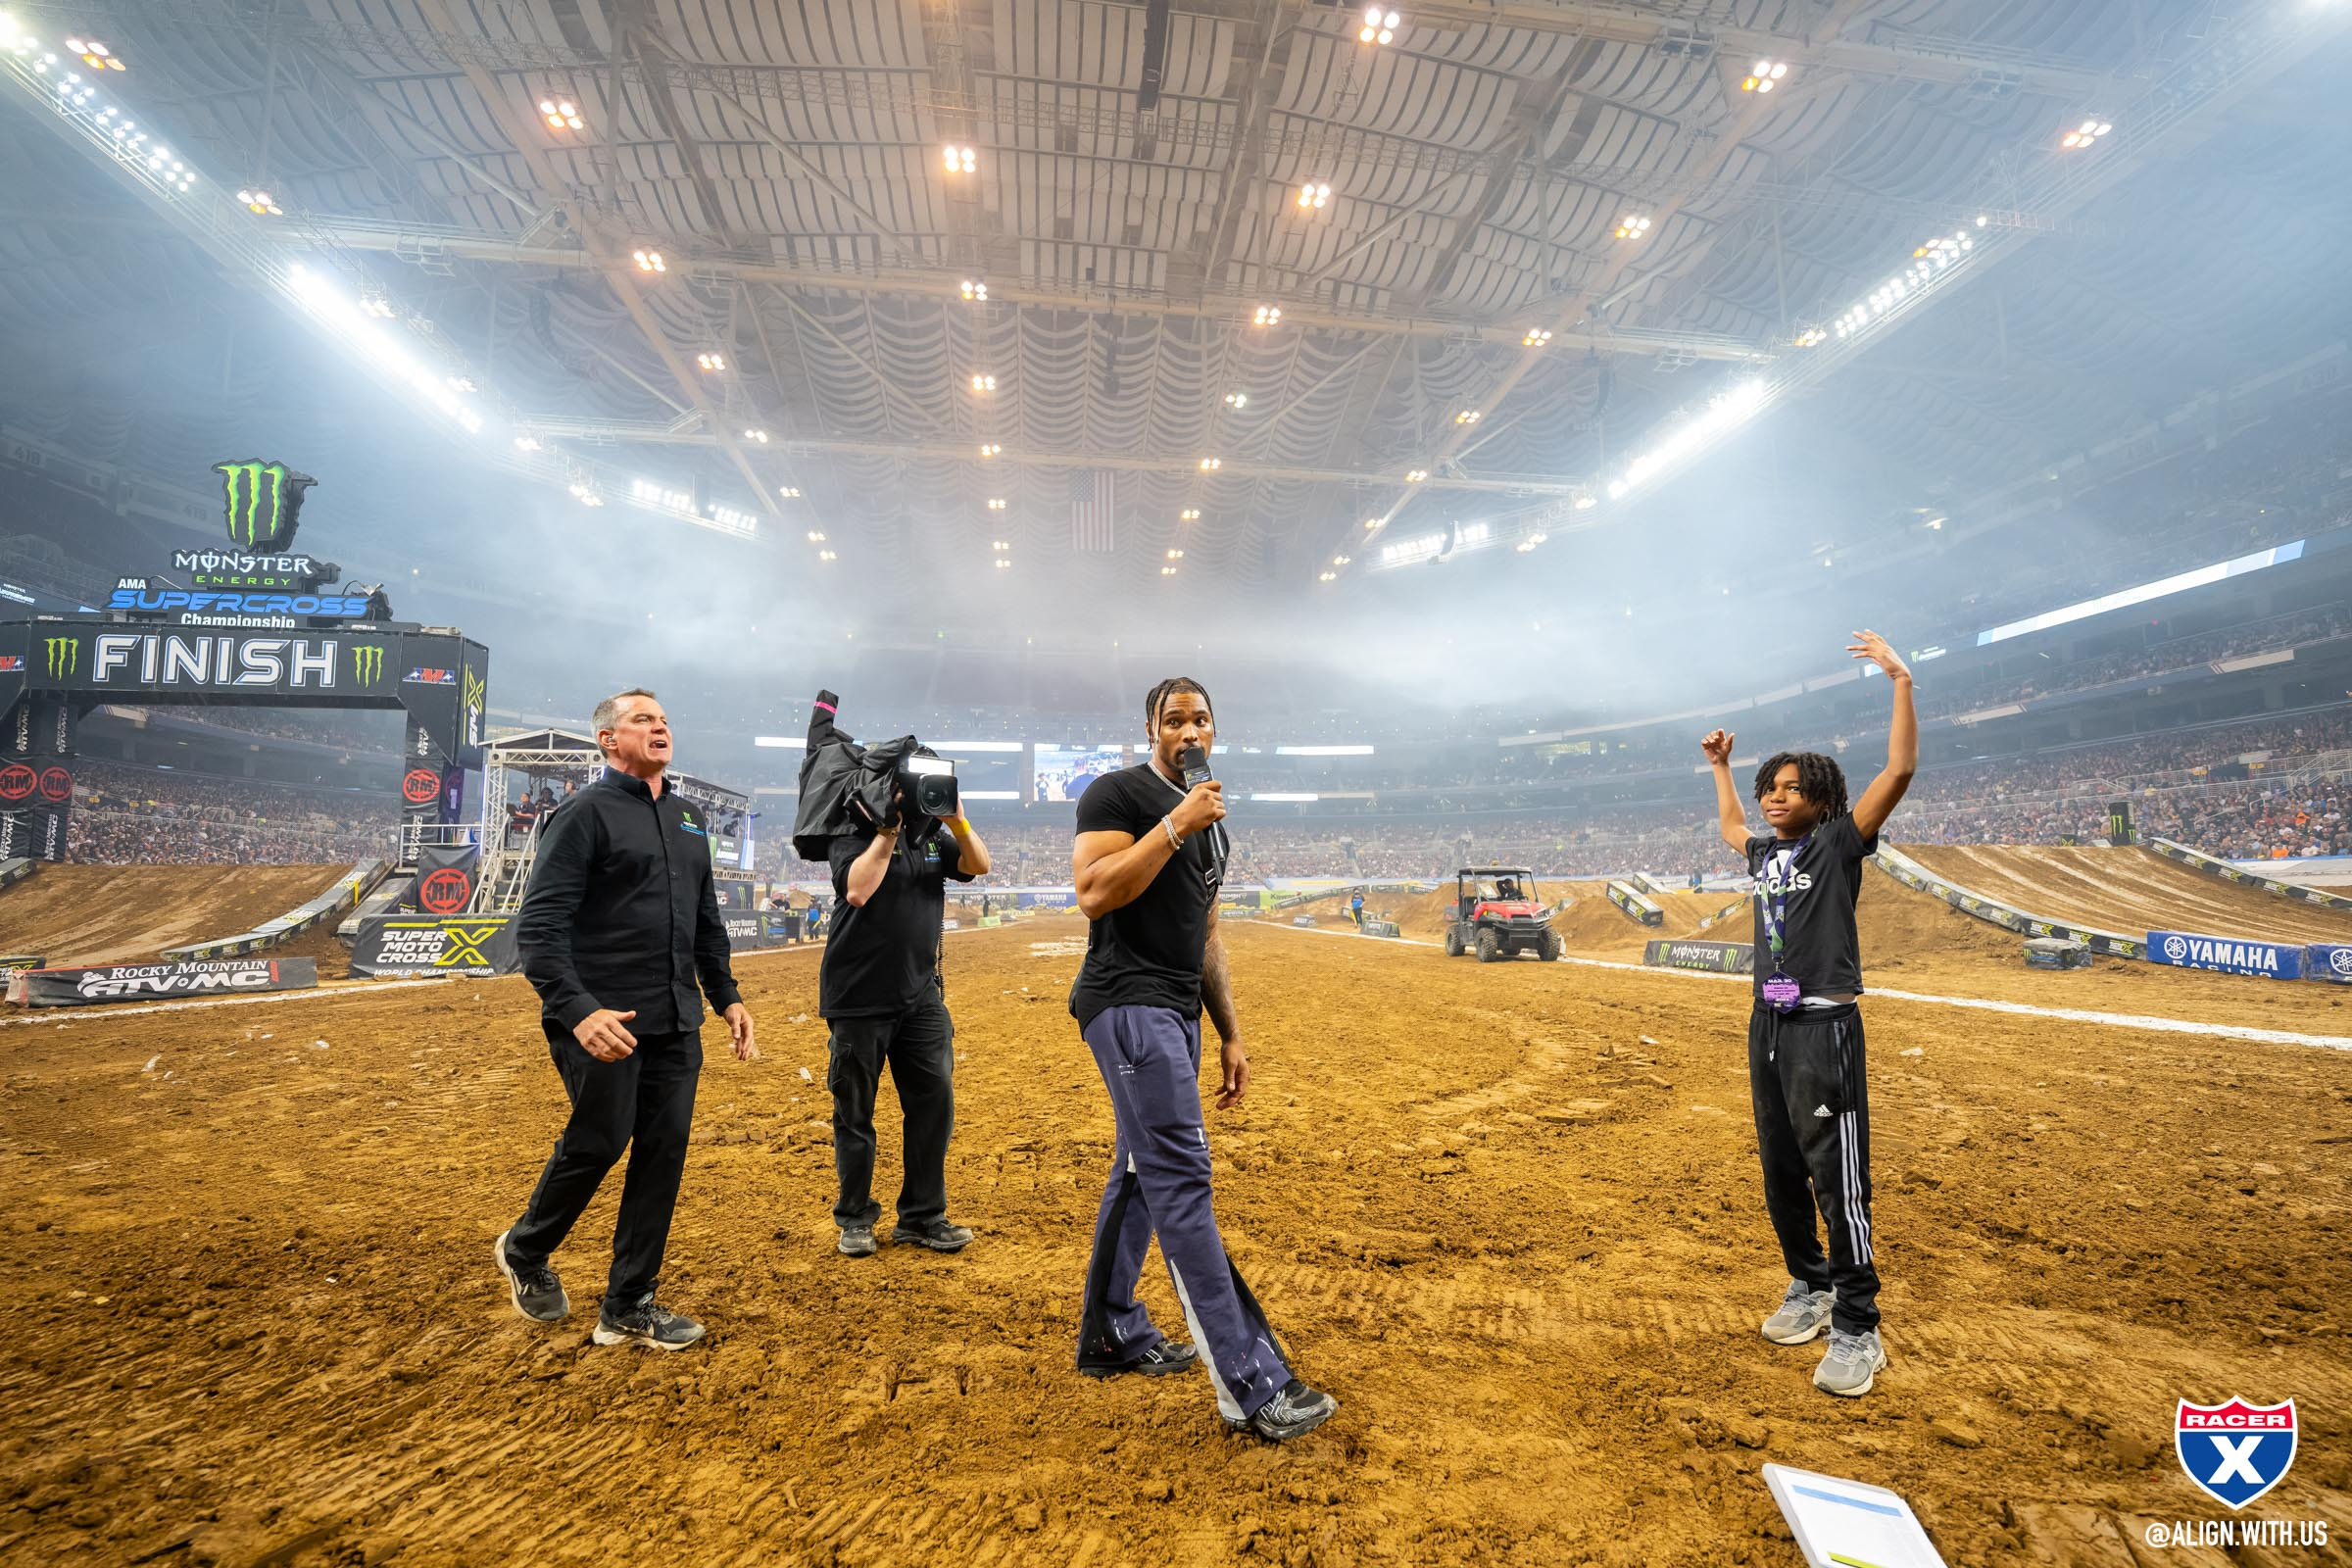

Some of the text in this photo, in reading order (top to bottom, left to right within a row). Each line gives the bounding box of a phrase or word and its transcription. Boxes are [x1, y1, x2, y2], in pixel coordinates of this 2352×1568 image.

[175, 551, 313, 574] MONSTER
[118, 578, 146, 589] AMA
[196, 575, 291, 586] ENERGY
[109, 590, 369, 615] SUPERCROSS
[180, 612, 295, 628] Championship
[93, 634, 338, 687] FINISH
[431, 882, 462, 901] RM
[380, 931, 448, 941] SUPER
[382, 942, 443, 952] MOTO
[1671, 945, 1721, 961] MONSTER
[376, 953, 443, 963] CROSS
[2189, 940, 2278, 971] YAMAHA
[110, 965, 172, 980] ROCKY
[175, 960, 269, 974] MOUNTAIN
